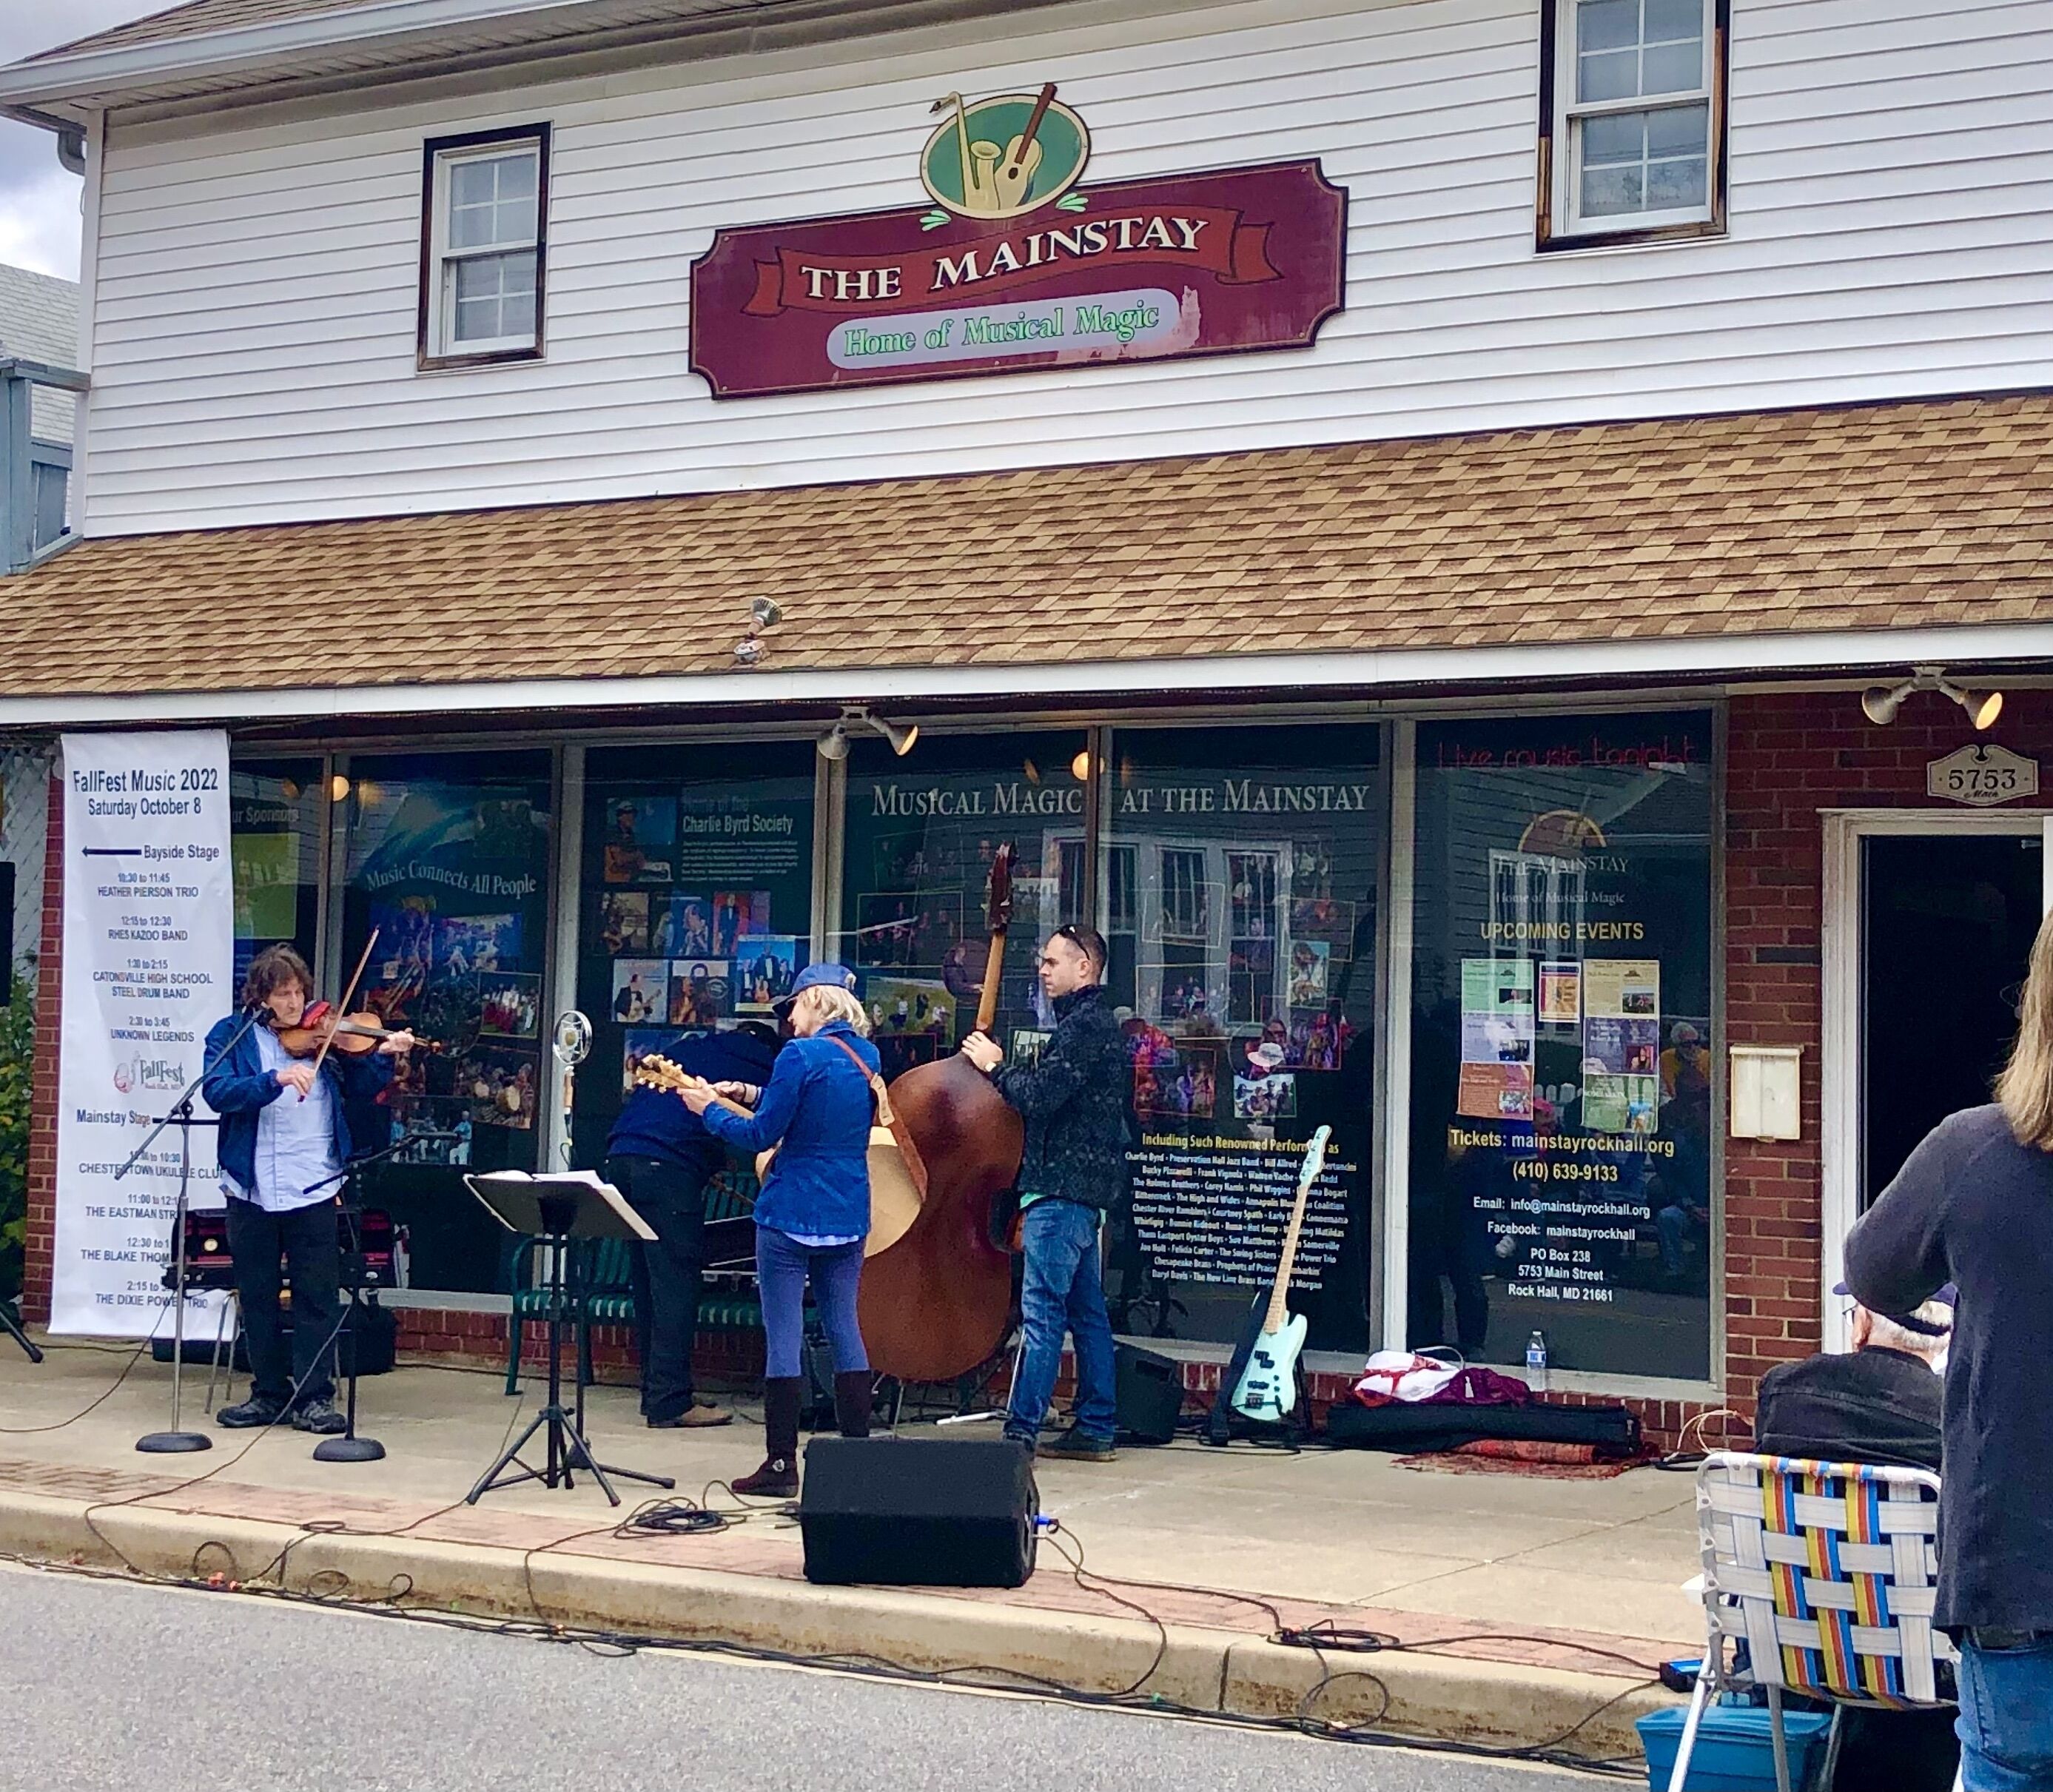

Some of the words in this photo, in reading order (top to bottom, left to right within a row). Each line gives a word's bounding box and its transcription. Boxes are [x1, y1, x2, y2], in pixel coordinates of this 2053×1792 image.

[801, 265, 902, 301] THE
[931, 217, 1209, 290] MAINSTAY
[844, 326, 918, 357] Home
[924, 321, 952, 349] of
[964, 308, 1064, 347] Musical
[1074, 300, 1160, 344] Magic
[73, 771, 127, 793] FallFest
[132, 770, 176, 792] Music
[181, 768, 218, 791] 2022
[1949, 769, 2015, 791] 5753
[872, 783, 985, 816] MUSICAL
[992, 782, 1082, 814] MAGIC
[1163, 787, 1214, 812] THE
[1221, 779, 1369, 812] MAINSTAY
[88, 798, 138, 819] Saturday
[141, 797, 189, 816] October
[194, 797, 201, 814] 8
[232, 810, 244, 823] ur
[246, 806, 299, 826] Sponsors
[683, 816, 722, 833] Charlie
[724, 815, 750, 836] Byrd
[753, 814, 793, 835] Society
[144, 845, 185, 862] Bayside
[188, 845, 220, 862] Stage
[139, 873, 147, 882] to
[149, 873, 170, 882] 11:45
[366, 865, 406, 891] Music
[409, 860, 468, 889] Connects
[470, 873, 490, 894] All
[492, 873, 537, 900] People
[98, 887, 132, 897] HEATHER
[134, 887, 173, 897] PIERSON
[175, 887, 198, 897] TRIO
[1591, 891, 1625, 907] Magic
[139, 916, 148, 925] to
[149, 916, 172, 925] 12:30
[131, 930, 160, 940] KAZOO
[161, 930, 188, 941] BAND
[1480, 922, 1570, 941] UPCOMING
[1576, 923, 1644, 941] EVENTS
[142, 959, 149, 969] to
[151, 959, 169, 970] 2:15
[147, 973, 167, 984] HIGH
[170, 973, 213, 984] SCHOOL
[112, 986, 136, 998] STEEL
[138, 987, 160, 998] DRUM
[163, 988, 189, 999] BAND
[144, 1017, 152, 1027] to
[154, 1017, 170, 1027] 3:45
[110, 1029, 149, 1041] UNKNOWN
[152, 1030, 194, 1042] LEGENDS
[140, 1060, 185, 1087] FallFest
[77, 1109, 127, 1127] Mainstay
[129, 1110, 151, 1128] Stage
[1143, 1132, 1188, 1150] Including
[1190, 1134, 1213, 1147] Such
[1215, 1135, 1269, 1151] Renowned
[1328, 1144, 1340, 1154] as
[1451, 1129, 1507, 1147] Tickets:
[1511, 1132, 1675, 1158] mainstayrockhall.org
[160, 1152, 181, 1162] 10:30
[78, 1163, 154, 1176] CHESTETOWN
[155, 1166, 195, 1178] UKULEE
[1513, 1161, 1548, 1181] (410)
[1553, 1164, 1618, 1181] 639-9133
[127, 1193, 151, 1204] 11:00
[161, 1195, 179, 1205] 12:1
[86, 1206, 105, 1217] THE
[108, 1207, 158, 1218] EASTMAN
[1474, 1196, 1505, 1209] Email:
[1511, 1198, 1650, 1220] info@mainstayrockhall.org
[1488, 1221, 1541, 1236] Facebook:
[1547, 1226, 1636, 1241] mainstayrockhall
[127, 1238, 151, 1248] 12:30
[154, 1239, 163, 1248] to
[81, 1249, 101, 1260] THE
[104, 1249, 137, 1262] BLAKE
[1530, 1248, 1547, 1261] PO
[1550, 1249, 1569, 1262] Box
[1572, 1249, 1591, 1263] 238
[1518, 1265, 1542, 1278] 5753
[1545, 1266, 1569, 1279] Main
[1572, 1267, 1603, 1282] Street
[127, 1281, 148, 1291] 2:15
[149, 1282, 160, 1292] to
[1508, 1283, 1534, 1297] Rock
[1536, 1286, 1559, 1300] Hall,
[1563, 1287, 1580, 1300] MD
[1582, 1289, 1613, 1301] 21661
[95, 1292, 114, 1304] THE
[117, 1294, 144, 1306] DIXIE
[188, 1297, 208, 1309] TRIO
